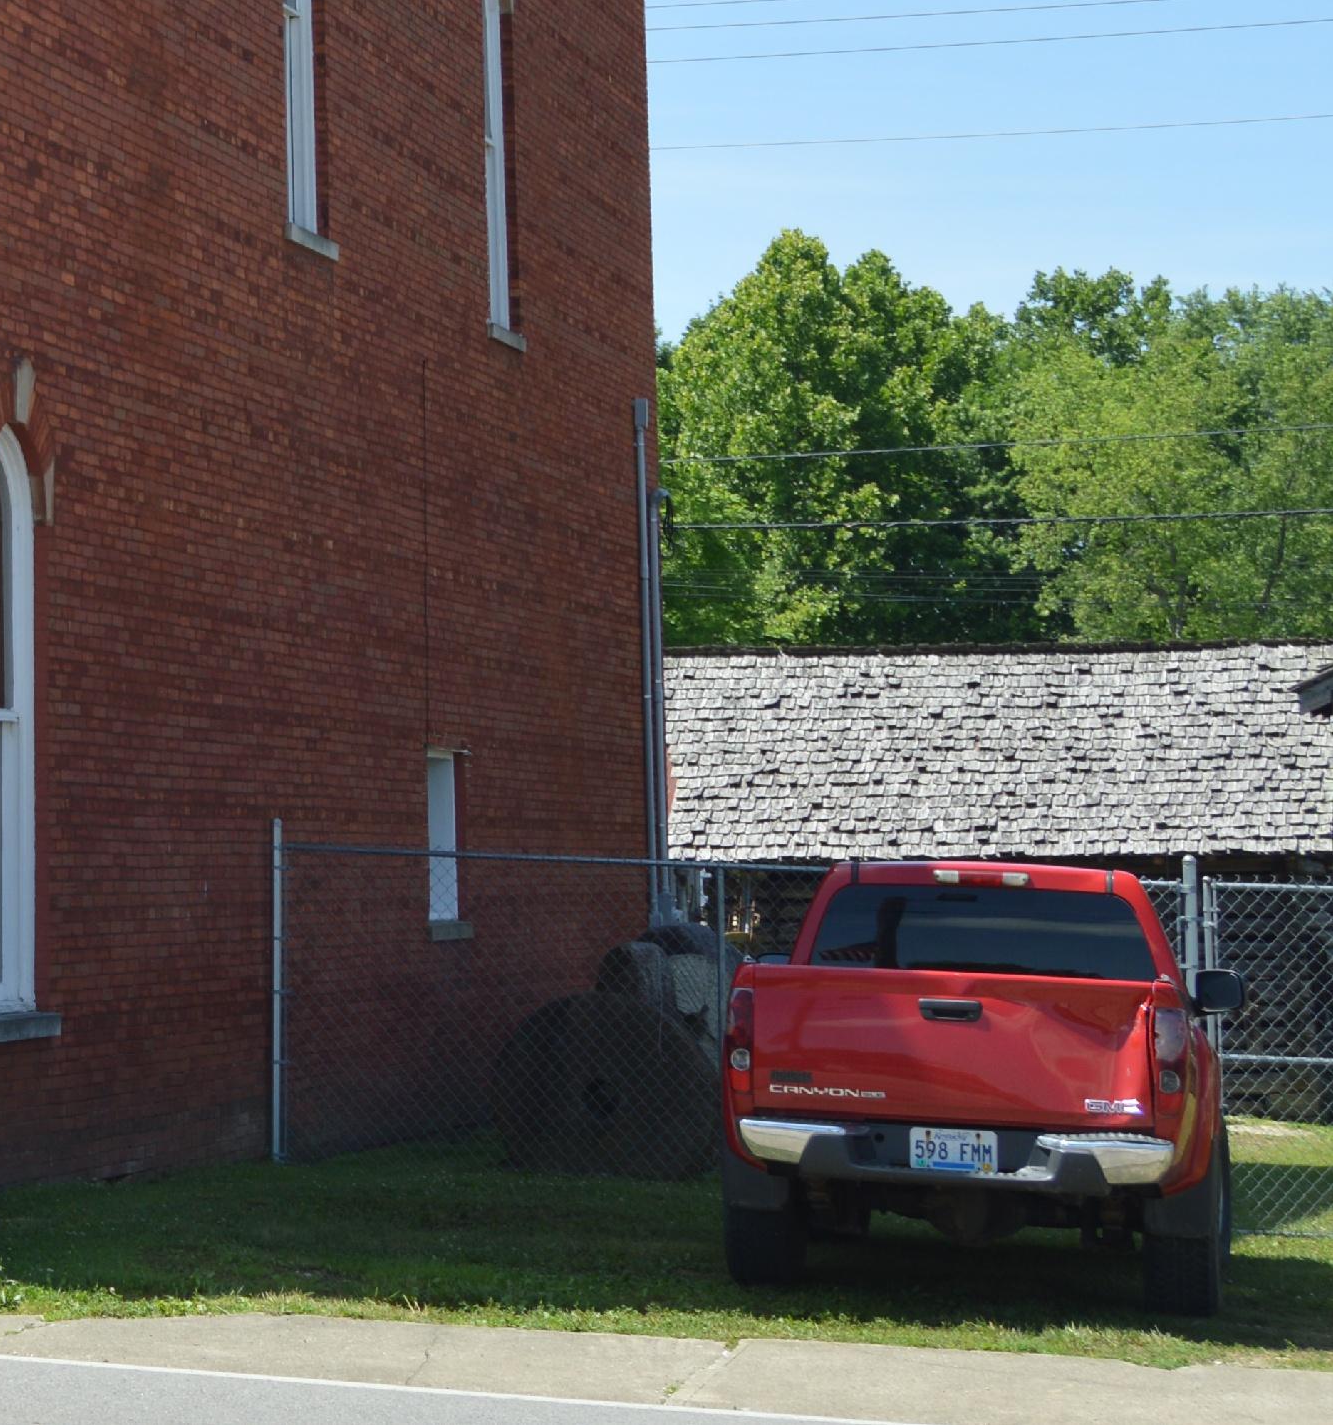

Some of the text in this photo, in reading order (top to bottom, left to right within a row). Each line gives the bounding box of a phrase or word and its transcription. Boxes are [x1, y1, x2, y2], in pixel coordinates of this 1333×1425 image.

[769, 1083, 860, 1098] CANYON
[1084, 1098, 1144, 1115] GMC
[915, 1139, 993, 1163] 598 FMM
